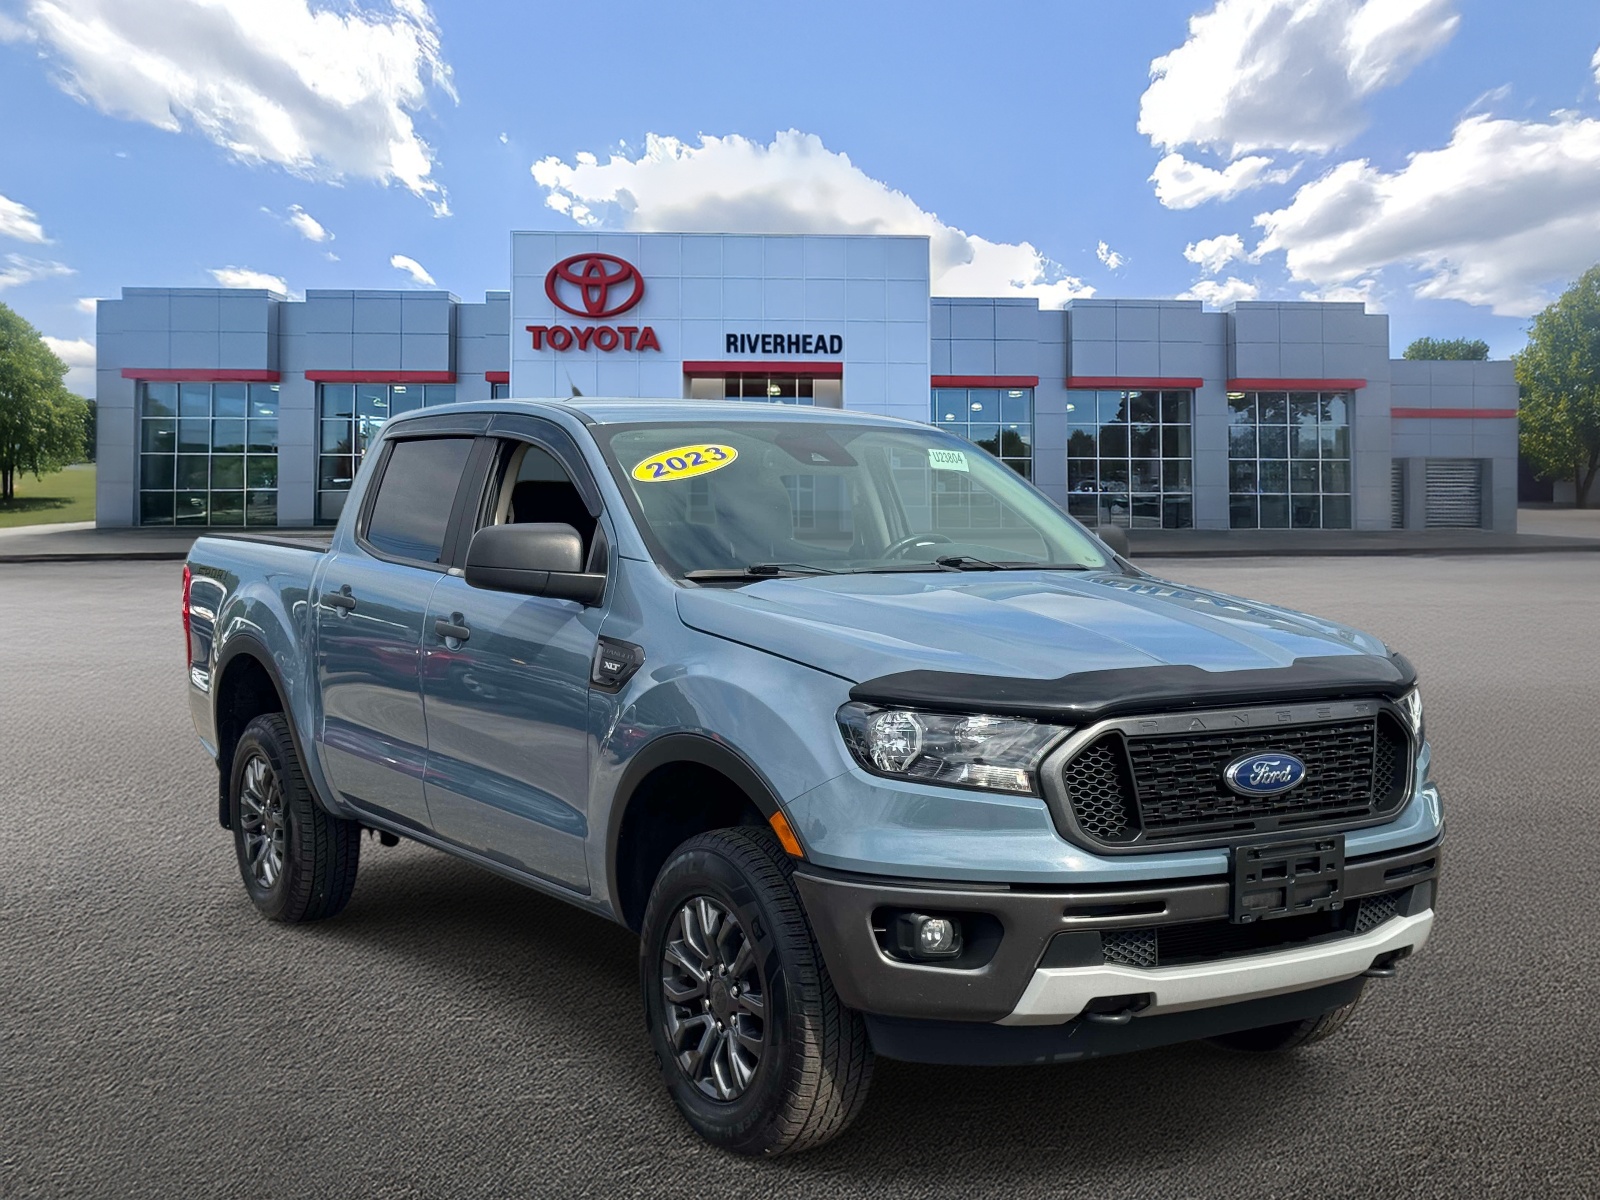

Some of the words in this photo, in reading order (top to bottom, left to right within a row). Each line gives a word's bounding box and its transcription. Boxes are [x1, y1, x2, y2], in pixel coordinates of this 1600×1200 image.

[526, 325, 660, 351] TOYOTA
[725, 333, 843, 354] RIVERHEAD
[645, 446, 727, 478] 2023
[932, 451, 963, 464] U23804
[603, 660, 621, 671] XLT
[1138, 702, 1370, 733] RANGER
[1249, 760, 1292, 786] Ford
